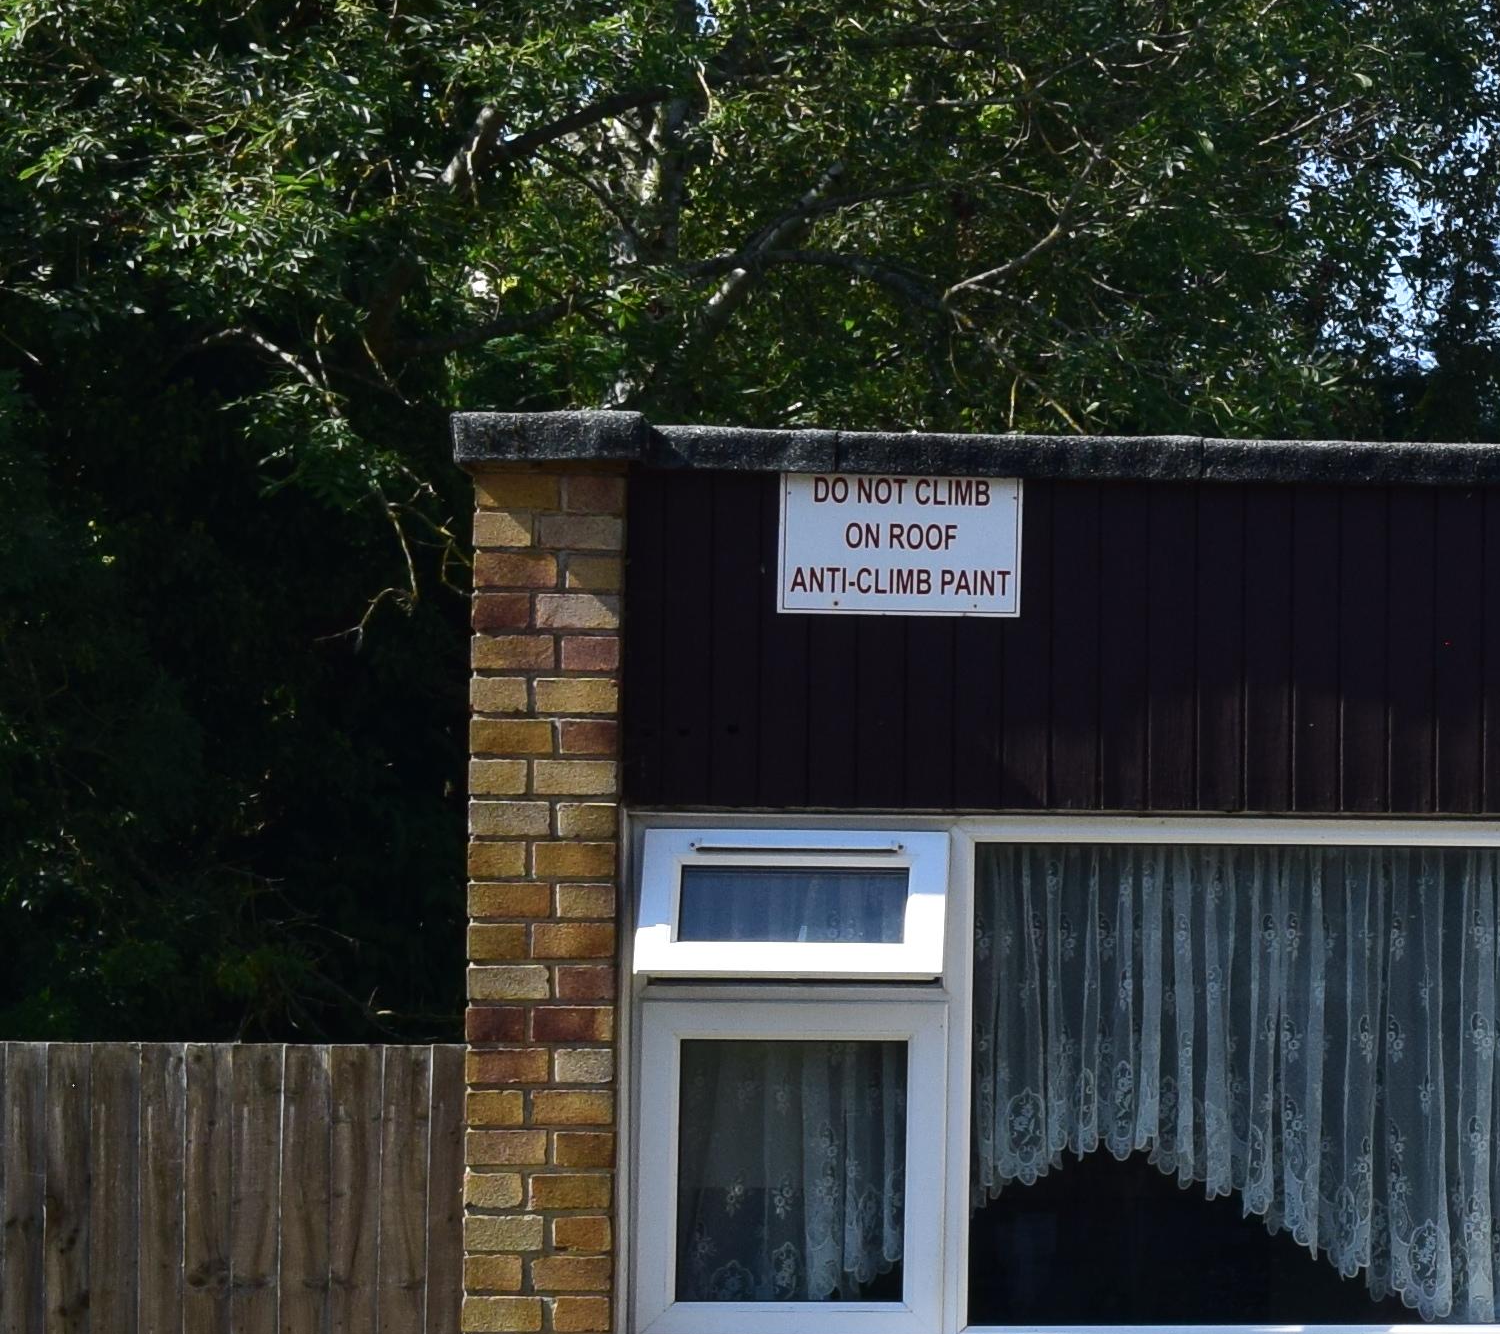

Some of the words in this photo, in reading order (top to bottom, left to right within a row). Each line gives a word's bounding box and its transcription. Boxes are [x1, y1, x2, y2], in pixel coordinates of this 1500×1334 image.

[814, 477, 849, 503] DO
[857, 478, 907, 504] NOT
[915, 480, 991, 506] CLIMB
[845, 522, 880, 549] ON
[889, 523, 957, 550] ROOF
[790, 567, 932, 594] ANTI-CLIMB
[940, 570, 1011, 596] PAINT
